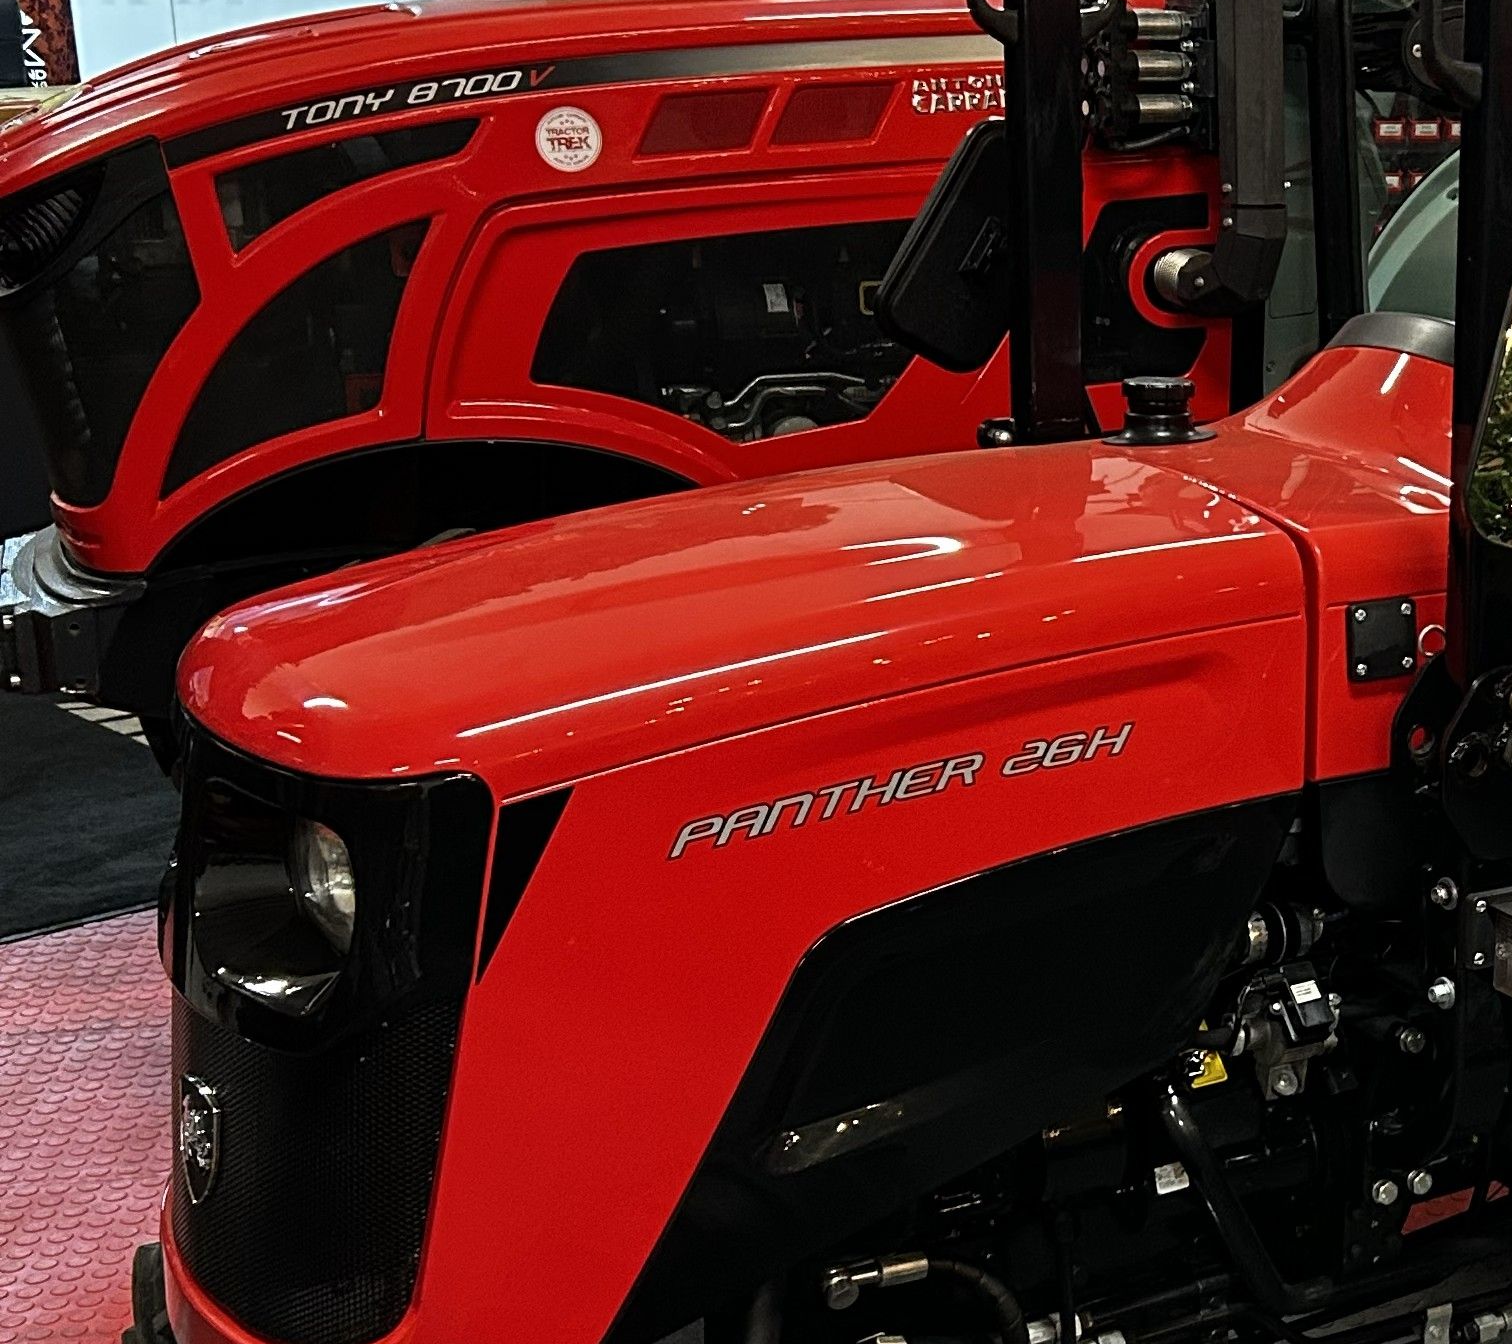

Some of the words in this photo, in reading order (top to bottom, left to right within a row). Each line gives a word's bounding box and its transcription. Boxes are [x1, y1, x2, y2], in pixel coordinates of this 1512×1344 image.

[281, 88, 395, 131] TONY
[407, 69, 523, 105] 8700
[545, 126, 590, 136] TRACTOR
[546, 135, 592, 152] TREK
[667, 752, 985, 860] PANTHER
[1000, 723, 1135, 778] 26H
